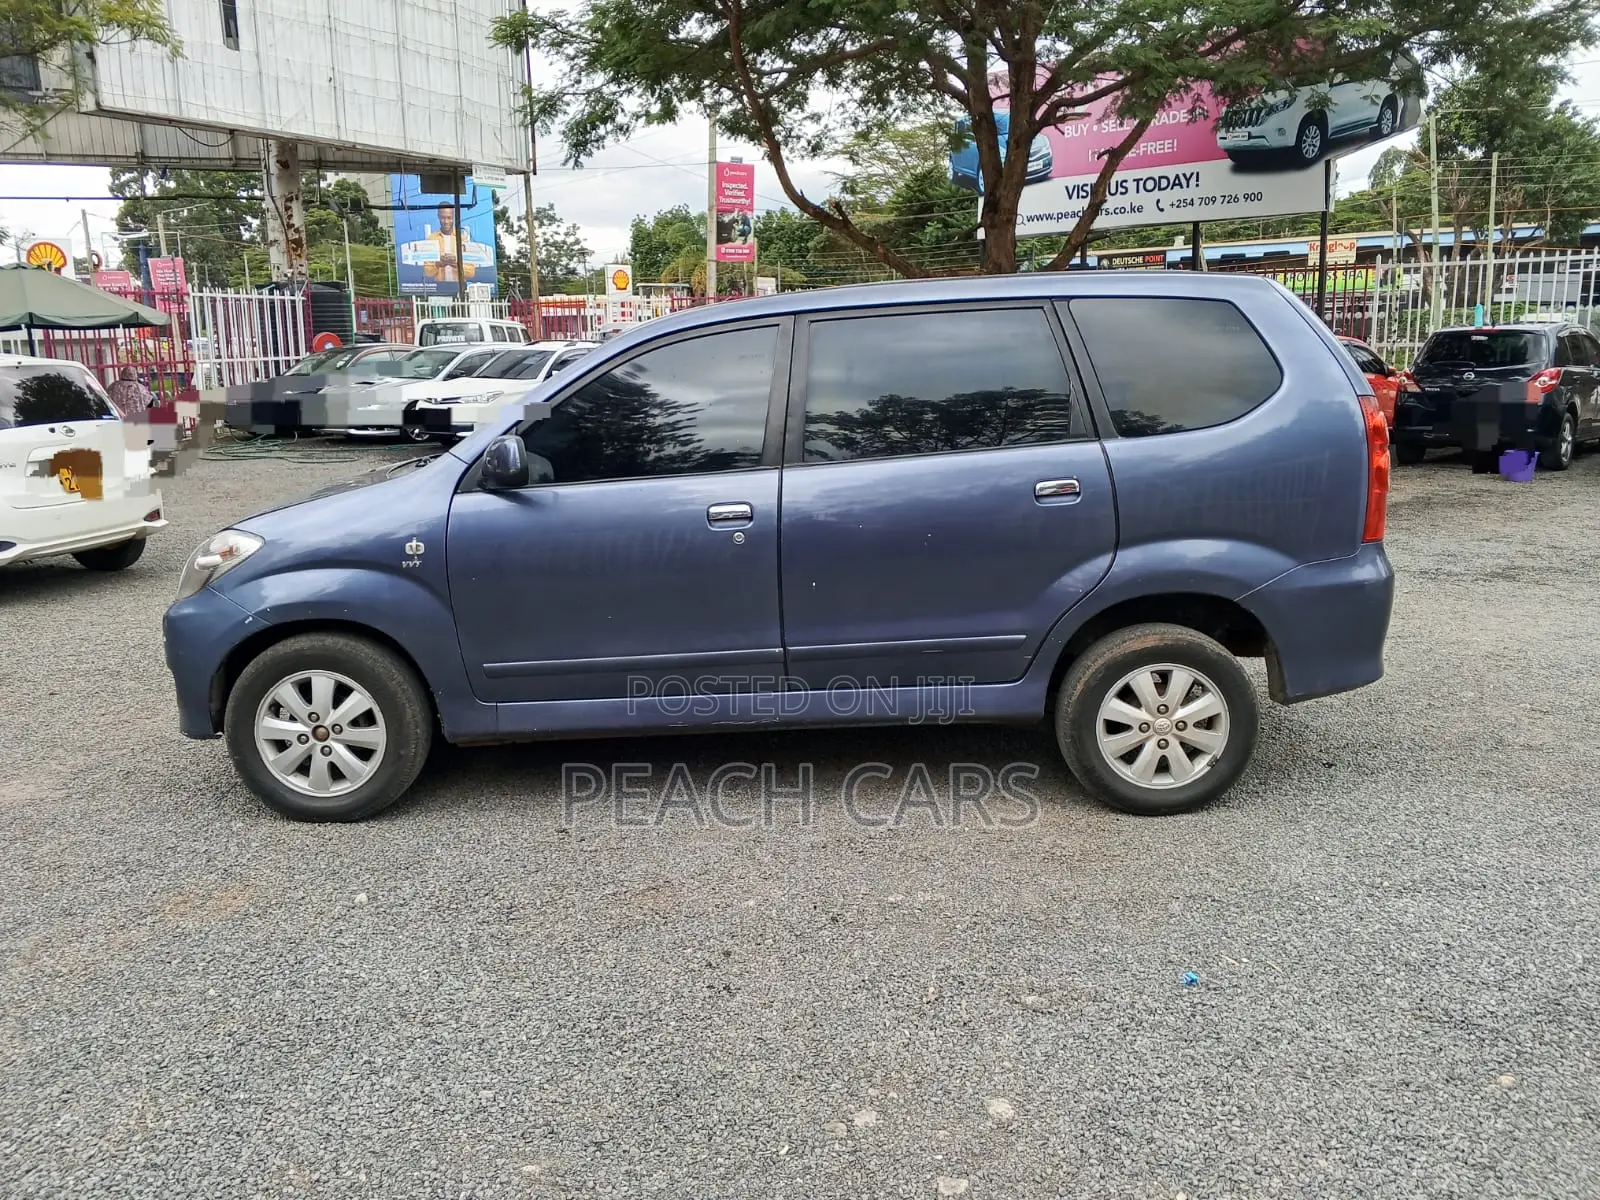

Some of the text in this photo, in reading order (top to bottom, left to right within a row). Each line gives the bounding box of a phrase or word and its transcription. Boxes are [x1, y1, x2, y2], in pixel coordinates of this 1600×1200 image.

[1064, 105, 1208, 138] BUY SELL RADE-IN
[1065, 172, 1200, 200] VISI US TODAY!
[1026, 192, 1263, 223] www.peacrs.co.ke +254 709 726 900
[1112, 254, 1165, 265] DEUTSCHE POINT
[436, 335, 466, 343] PRIVATE
